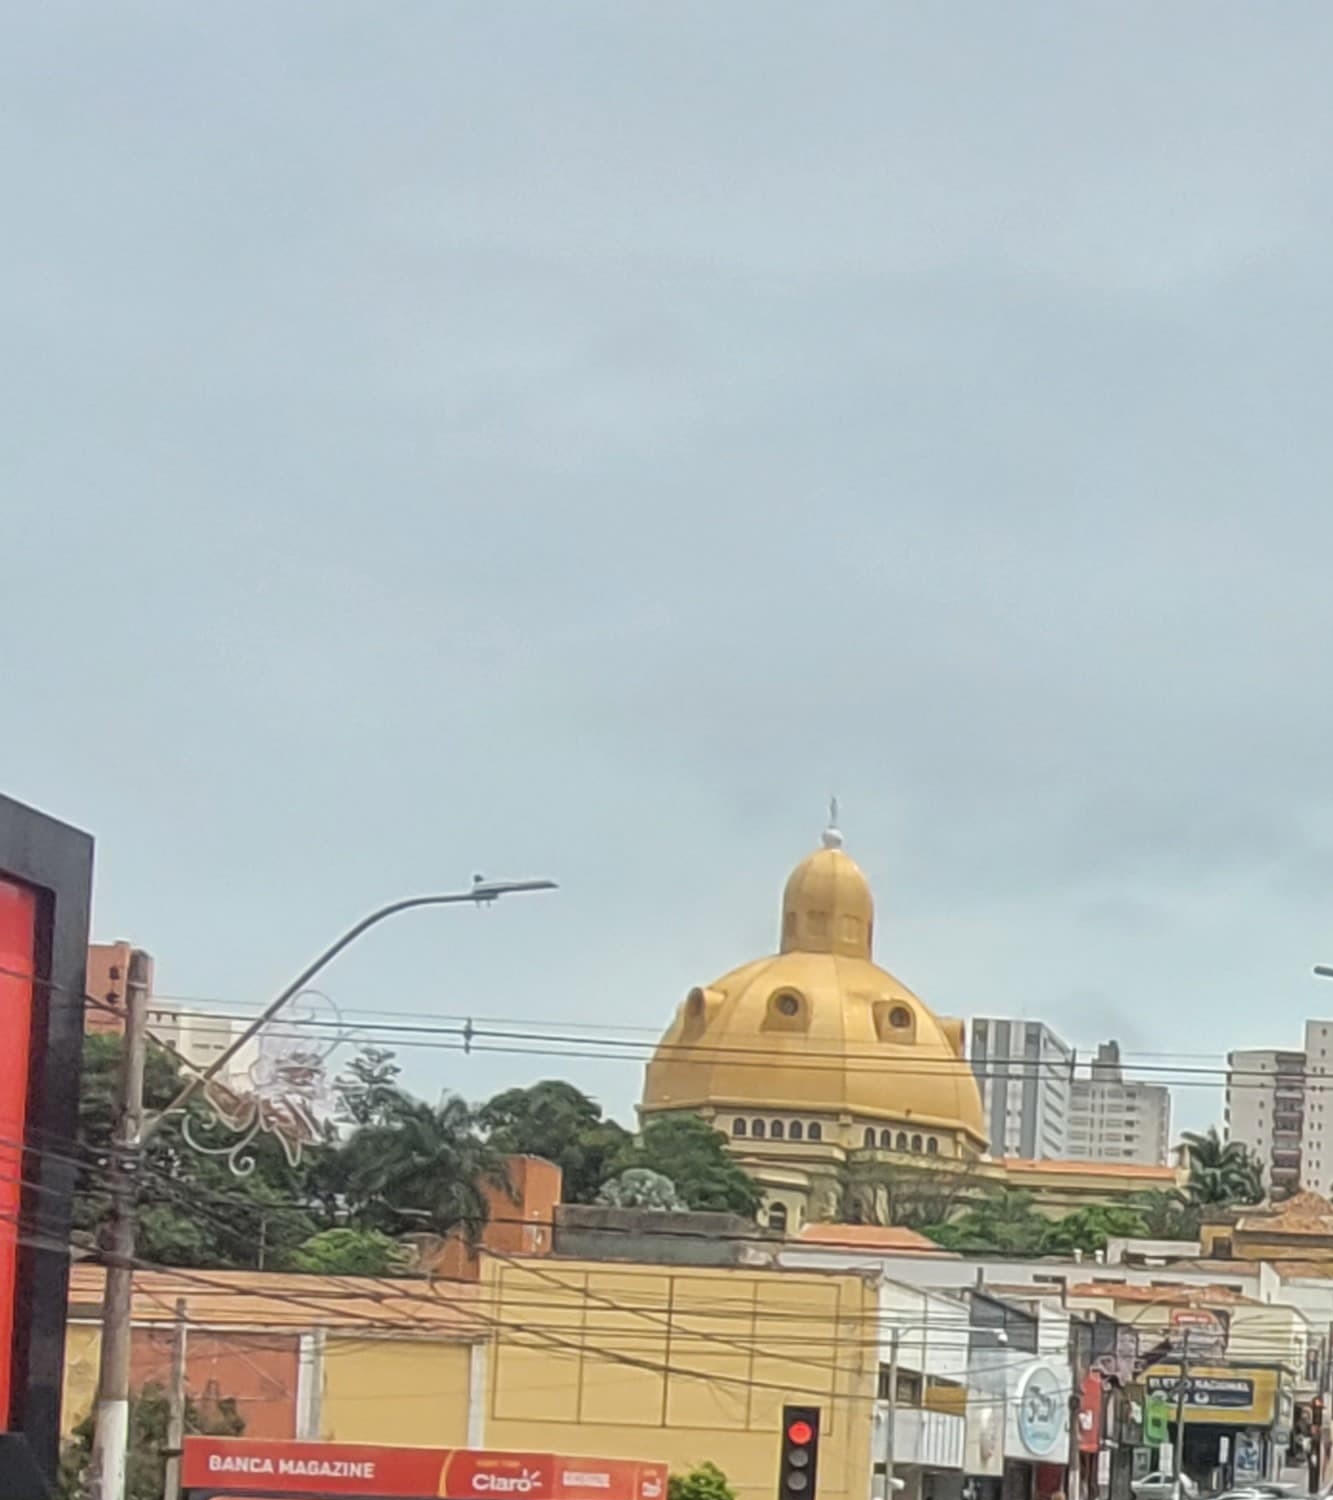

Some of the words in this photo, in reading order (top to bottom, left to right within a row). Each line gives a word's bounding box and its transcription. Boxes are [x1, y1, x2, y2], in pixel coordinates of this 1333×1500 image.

[208, 1455, 274, 1474] BANCA
[279, 1458, 375, 1479] MAGAZINE
[472, 1470, 537, 1492] Claro
